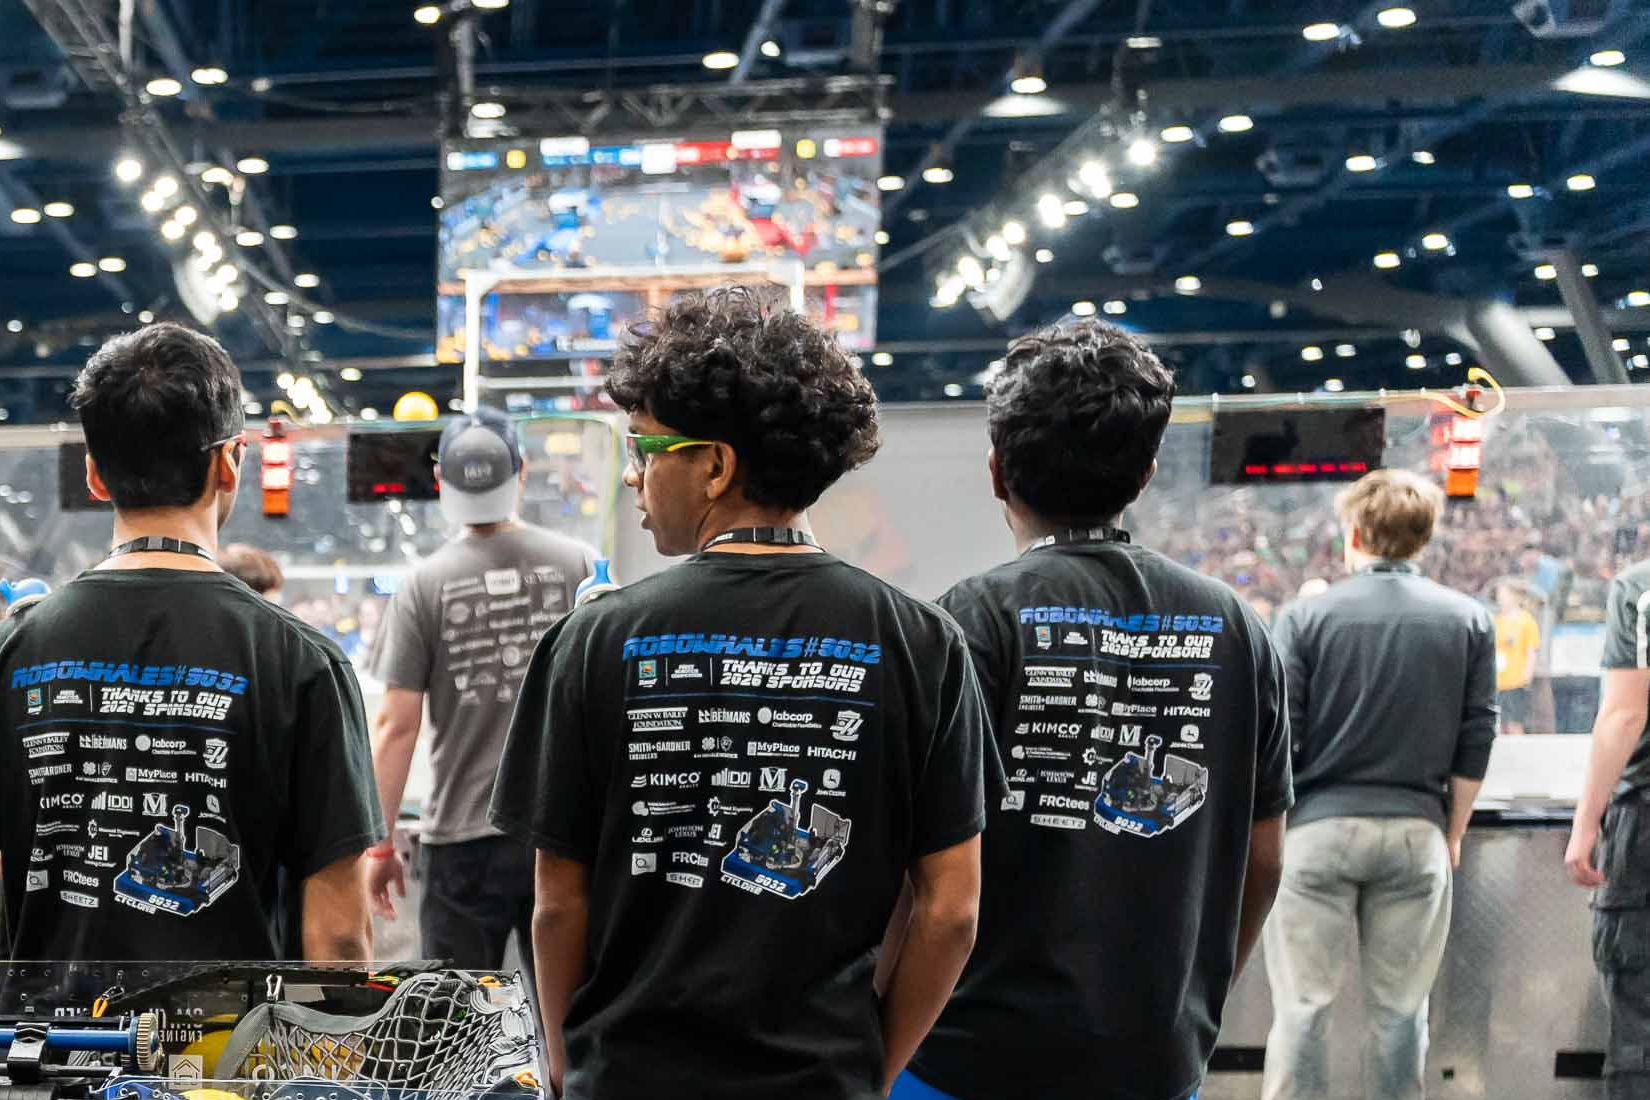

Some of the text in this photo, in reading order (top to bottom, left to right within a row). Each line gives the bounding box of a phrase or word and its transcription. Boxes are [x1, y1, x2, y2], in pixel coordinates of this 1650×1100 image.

[1158, 636, 1175, 647] TO
[1184, 636, 1214, 648] OUR
[1129, 646, 1212, 658] SPONSORS
[721, 659, 789, 676] THANKS
[798, 663, 823, 676] TO
[829, 664, 866, 680] OUR
[720, 672, 762, 686] 2026
[766, 675, 862, 693] SPONSORS
[1132, 676, 1170, 688] labcorp
[101, 688, 233, 709] THANKS TO OUR
[100, 701, 229, 720] 2026 SPONSORS
[773, 710, 813, 724] labcorp
[1164, 706, 1210, 717] HITACHI
[1032, 722, 1082, 735] KIMCO
[152, 738, 186, 751] labcorp
[757, 742, 800, 755] MyPlace
[807, 746, 856, 761] HITACHI
[138, 769, 177, 780] MyPlace
[185, 772, 227, 789] HITACHI
[650, 772, 700, 786] KIMCO
[108, 795, 133, 809] IDDI
[88, 845, 108, 861] JEI
[63, 870, 99, 887] FRCtees
